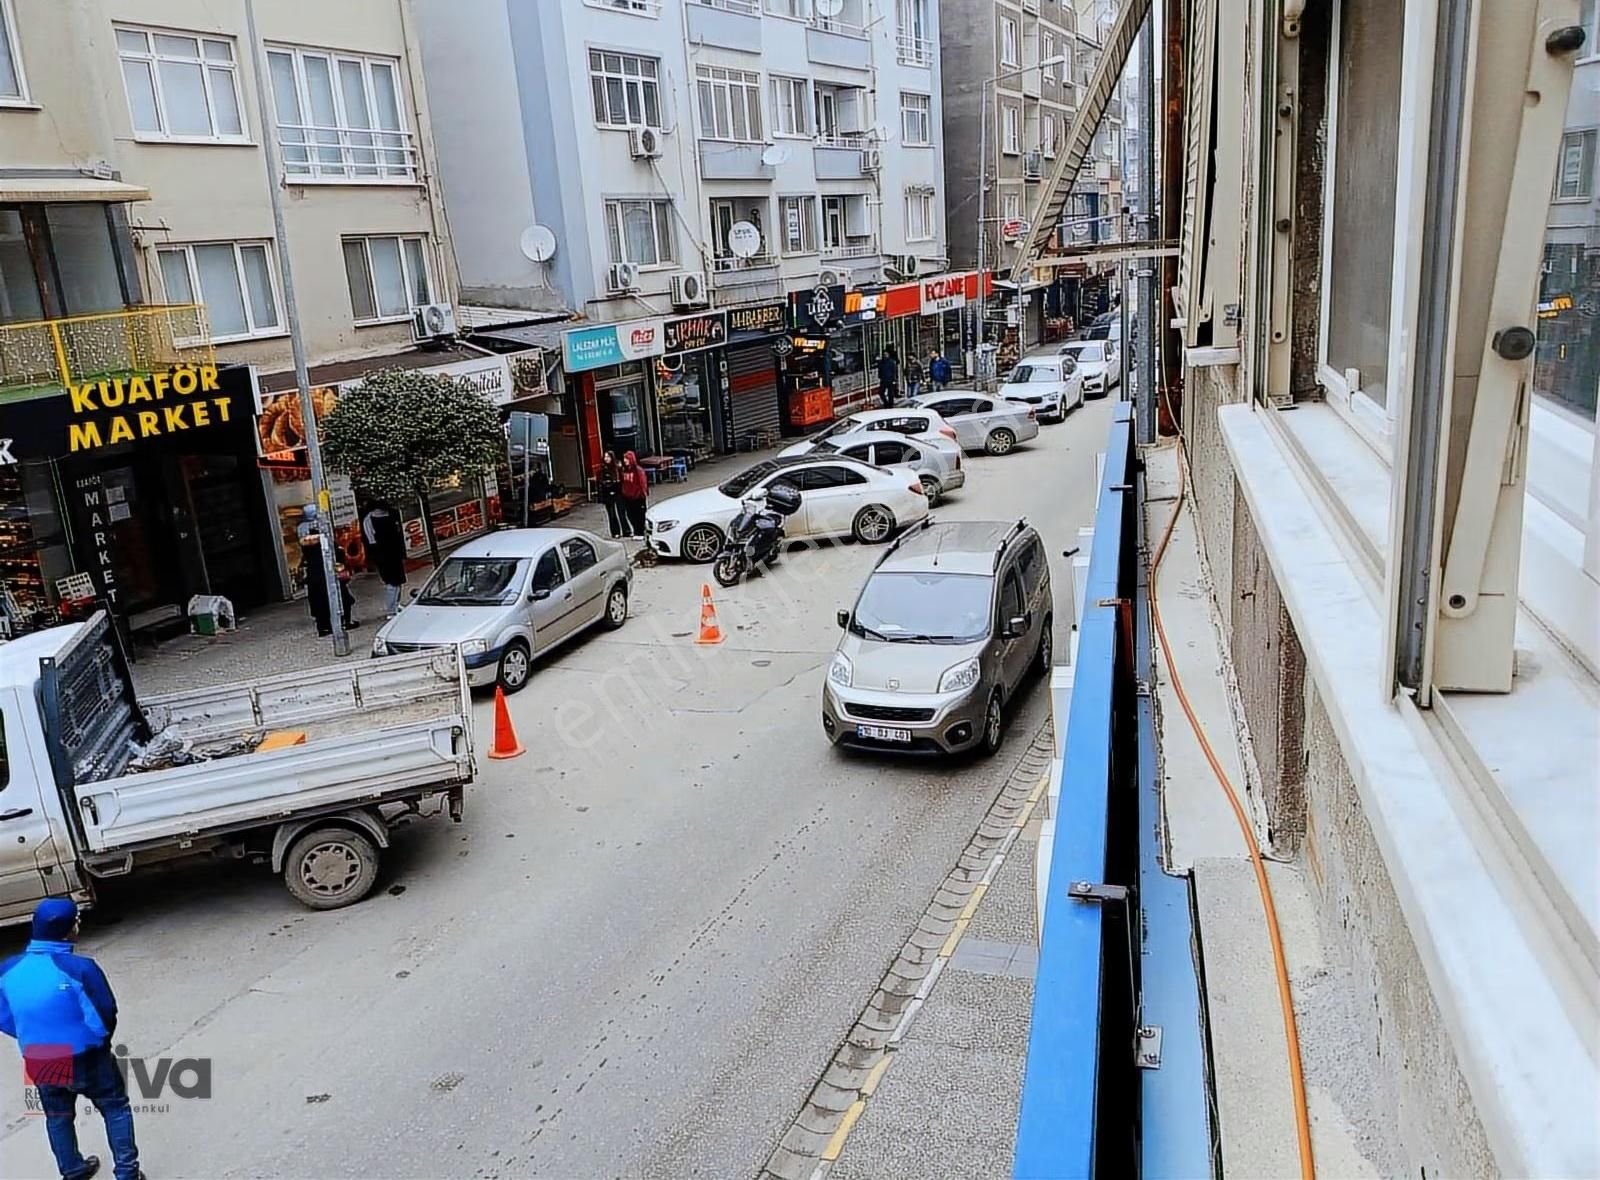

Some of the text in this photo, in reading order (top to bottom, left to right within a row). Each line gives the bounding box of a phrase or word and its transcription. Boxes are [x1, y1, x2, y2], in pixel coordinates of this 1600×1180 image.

[69, 363, 220, 413] KUAFÖR
[68, 397, 231, 452] MARKET
[84, 492, 117, 602] MARKET
